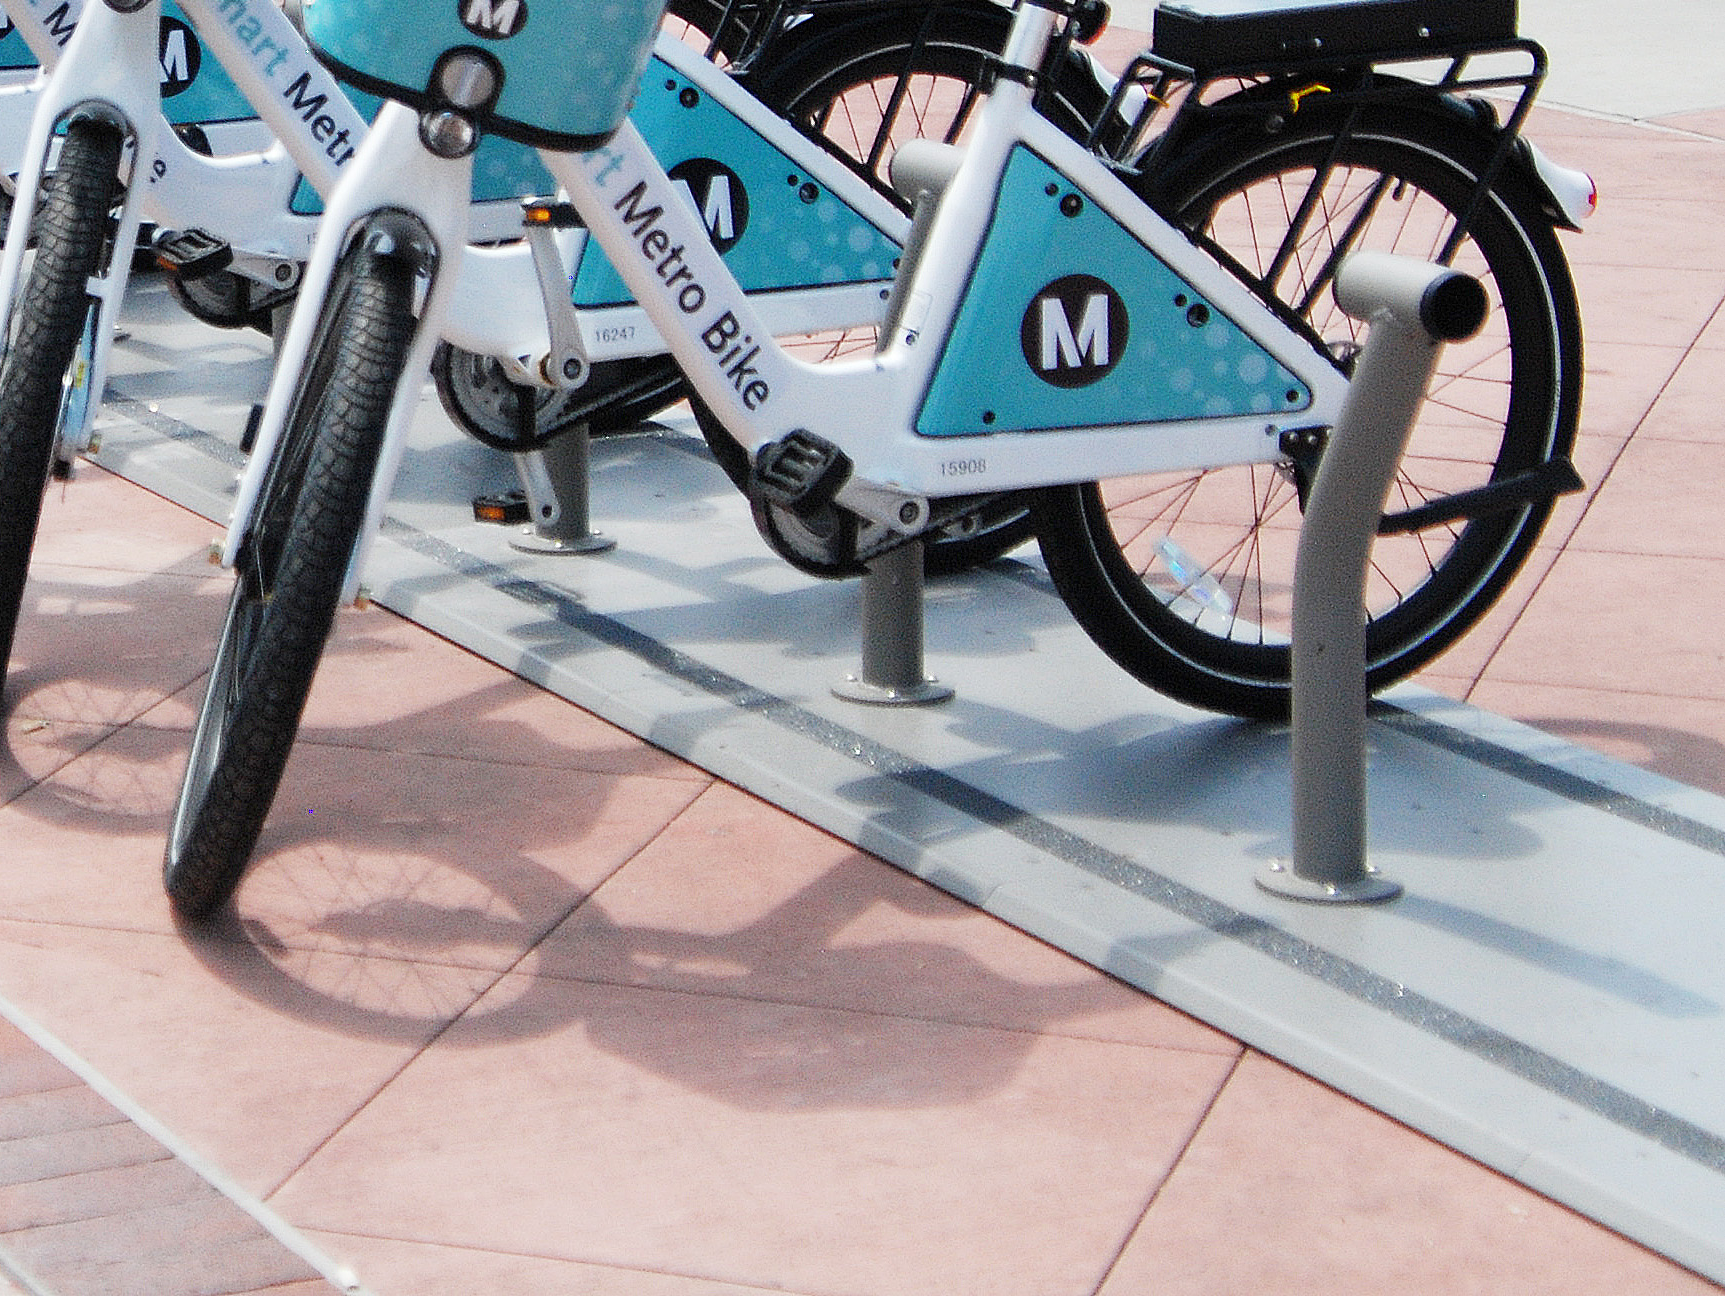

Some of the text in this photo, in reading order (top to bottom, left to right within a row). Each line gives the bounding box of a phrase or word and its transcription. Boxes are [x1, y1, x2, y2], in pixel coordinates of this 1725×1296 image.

[282, 70, 356, 167] Metr
[614, 180, 770, 412] Metro Bike
[594, 325, 637, 343] 16247
[940, 458, 987, 477] 15908
